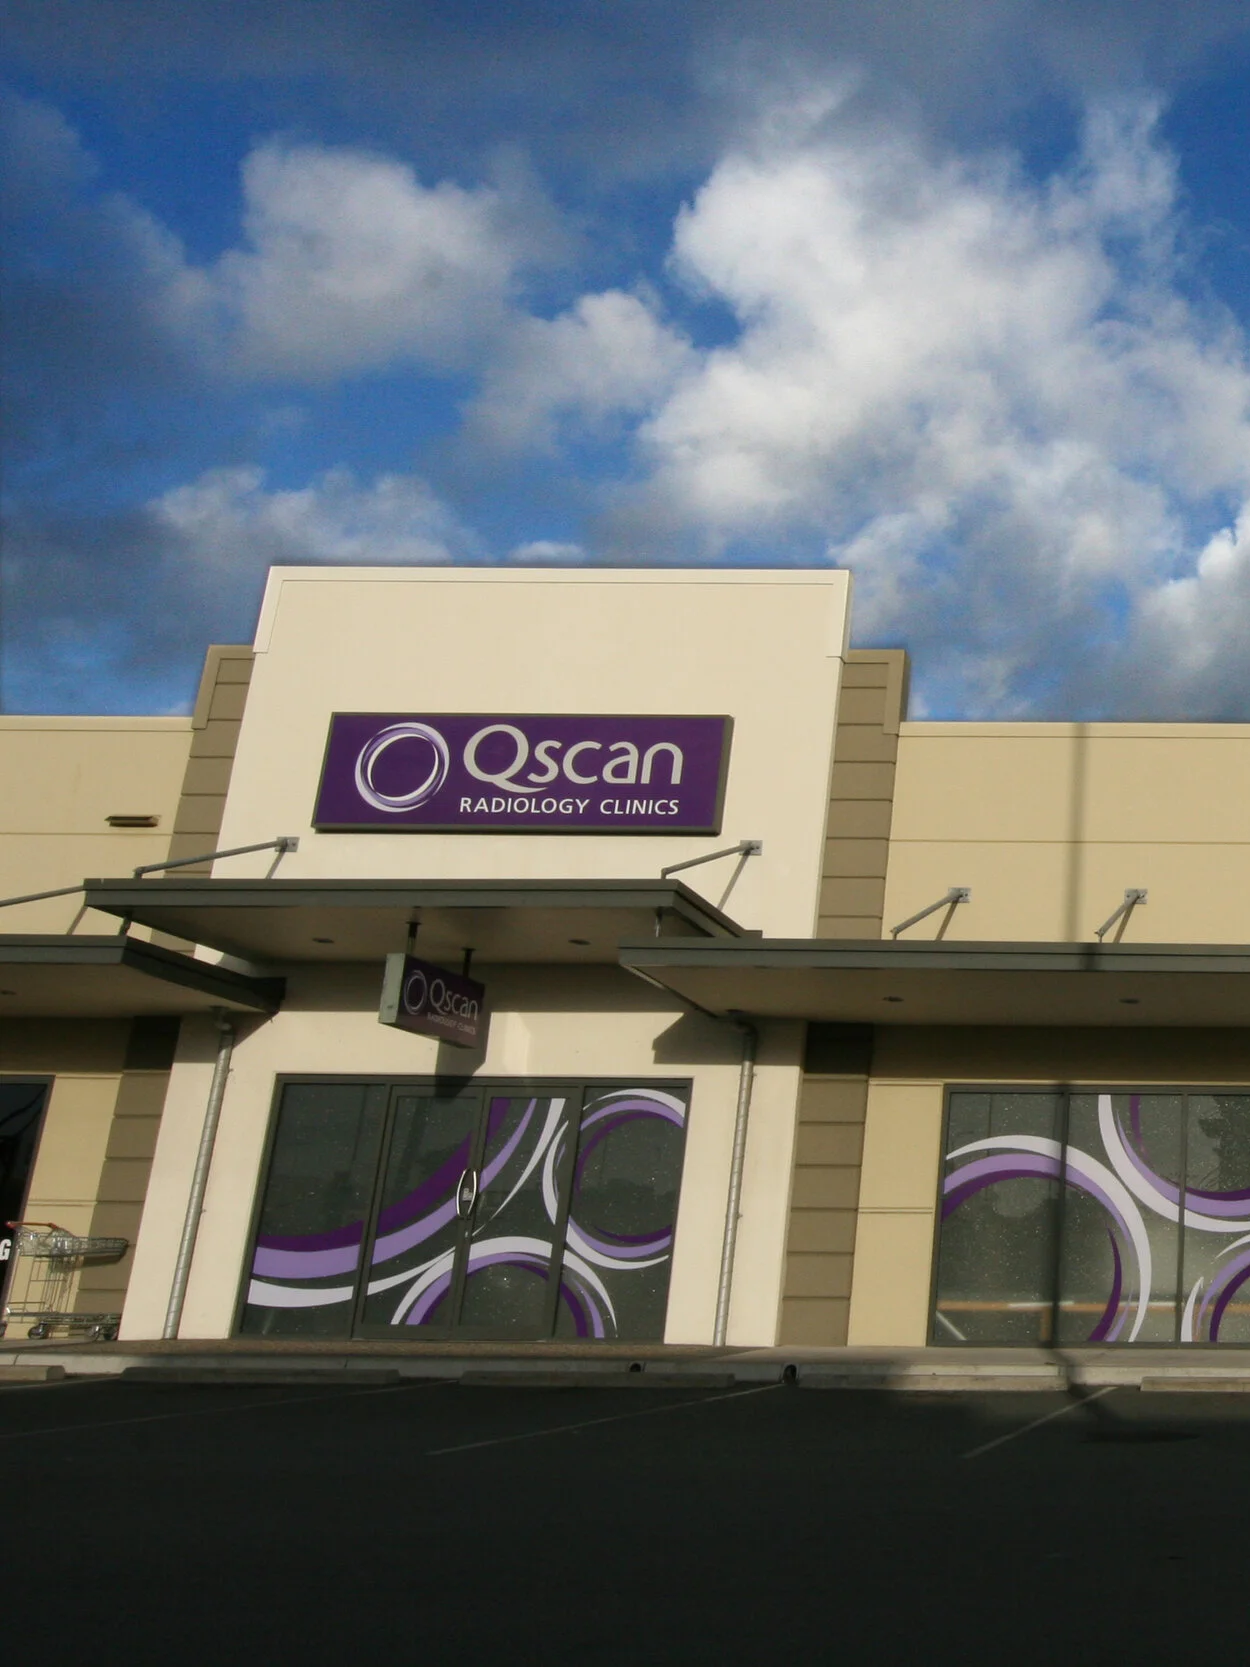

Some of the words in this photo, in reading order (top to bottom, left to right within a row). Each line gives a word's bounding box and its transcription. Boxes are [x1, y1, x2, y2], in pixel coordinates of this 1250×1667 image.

[463, 724, 683, 793] Qscan
[459, 797, 590, 815] RADIOLOGY
[600, 799, 680, 816] CLINICS
[429, 979, 478, 1021] Qscan
